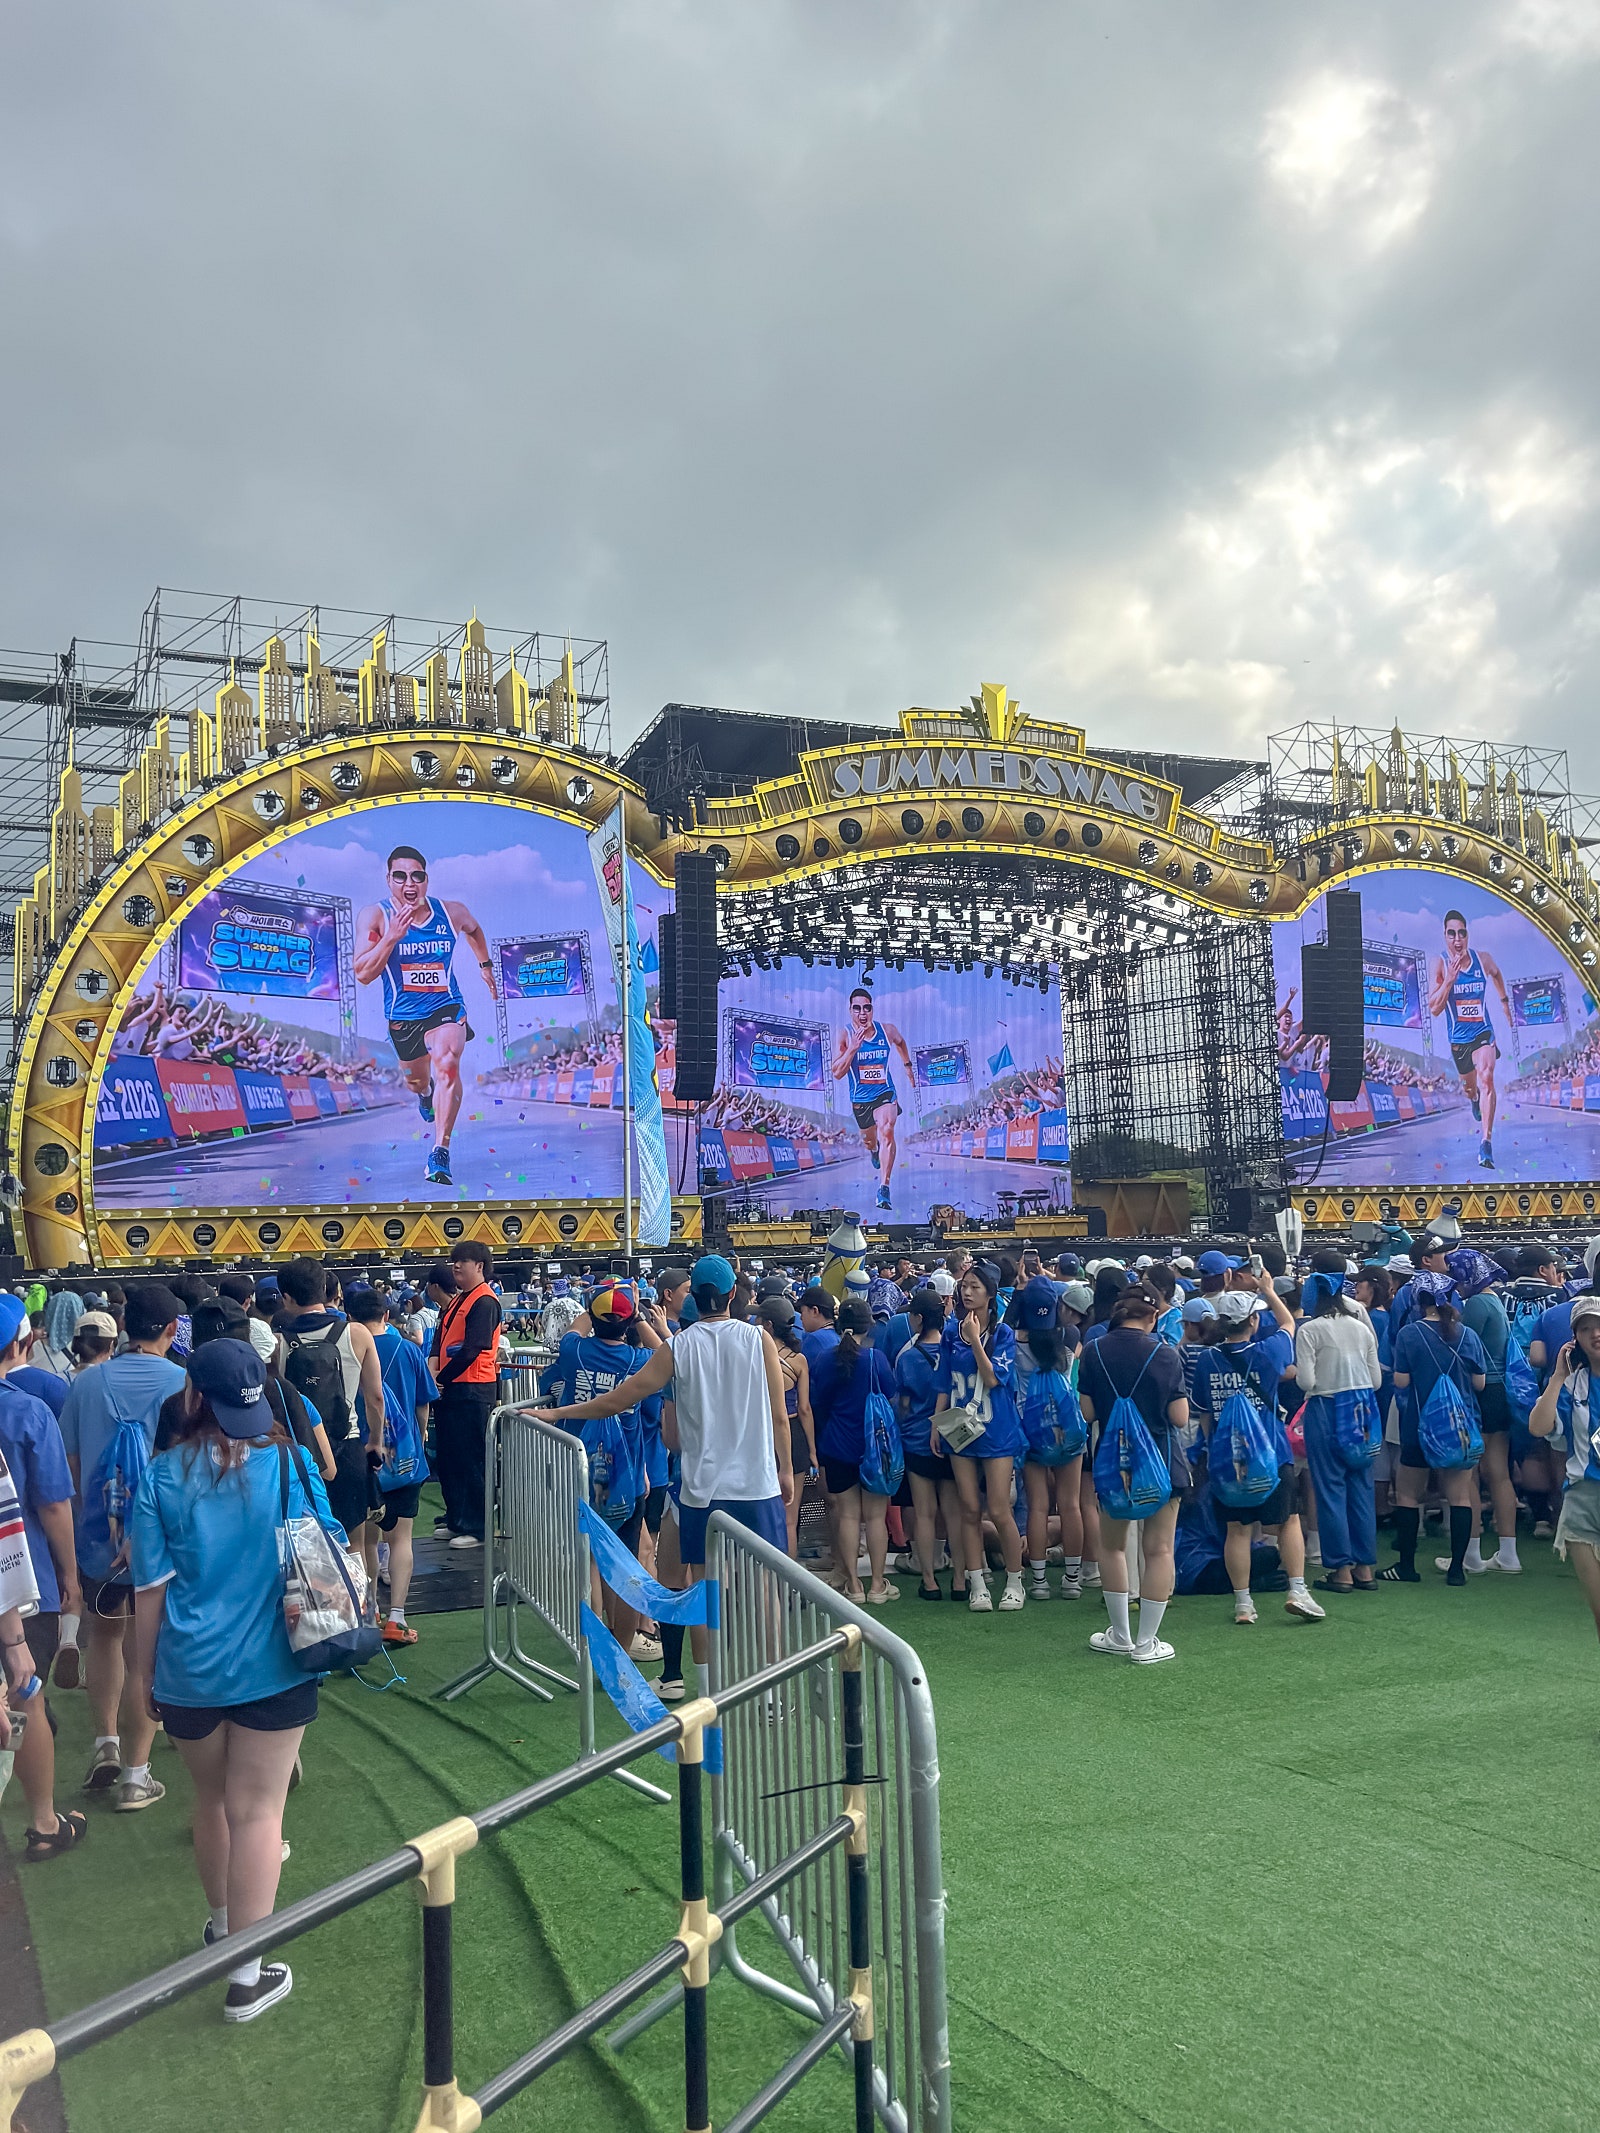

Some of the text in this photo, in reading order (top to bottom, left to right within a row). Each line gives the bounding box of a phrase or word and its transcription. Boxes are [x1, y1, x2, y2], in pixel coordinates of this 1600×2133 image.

[215, 923, 311, 951] SUMMER
[435, 924, 448, 935] 42
[398, 940, 451, 956] INPSYDER
[212, 942, 311, 974] SWAG
[519, 959, 566, 973] SUMMER
[410, 971, 440, 985] 2026
[518, 968, 566, 985] SWAG
[1363, 988, 1405, 1010] WAG
[1461, 1006, 1479, 1016] 2026
[753, 1042, 807, 1059] SUMMER
[751, 1054, 807, 1074] SWAG
[864, 1070, 882, 1079] 2026
[114, 1078, 161, 1120] 2026
[1298, 1088, 1326, 1119] 2026
[1042, 1125, 1066, 1146] SUMMER
